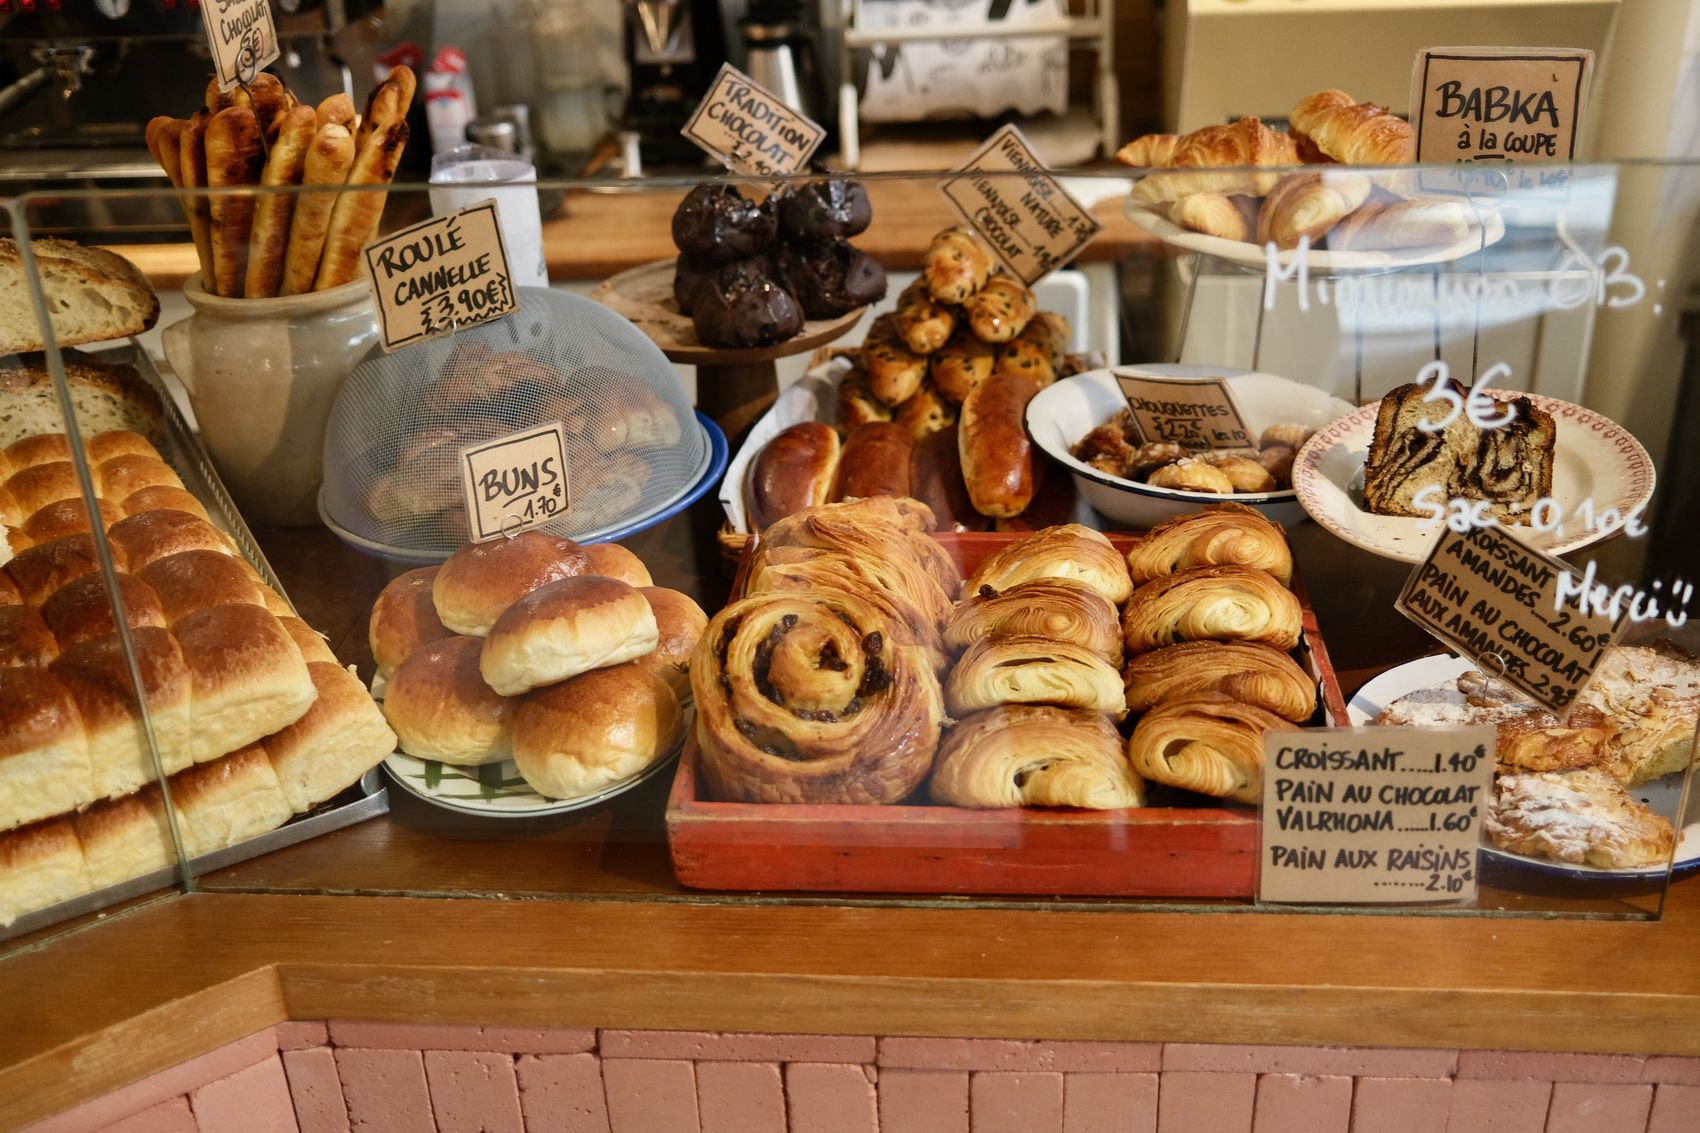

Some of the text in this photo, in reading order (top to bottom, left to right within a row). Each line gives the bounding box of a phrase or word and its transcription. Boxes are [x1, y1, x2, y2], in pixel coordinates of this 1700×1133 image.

[725, 80, 811, 151] TRADITION
[1435, 80, 1559, 127] BABKA
[708, 102, 794, 164] CHOCOLAT
[1457, 124, 1557, 156] à la COUPE
[975, 206, 1023, 258] CHOCOLAT
[1020, 192, 1064, 238] NATURE
[376, 216, 466, 279] ROULÉ
[395, 253, 490, 306] CANNELLE
[439, 279, 499, 316] 3.90€
[1415, 360, 1518, 432] 3€
[479, 457, 557, 501] BUNS
[1456, 524, 1556, 590] ROISSANT
[1411, 588, 1449, 620] AUX
[1422, 564, 1590, 684] PAIN AU CHOCOLAT
[1276, 779, 1480, 805] PAIN AU CHOCOLAT
[1270, 844, 1472, 872] PAIN AUX RAISINS
